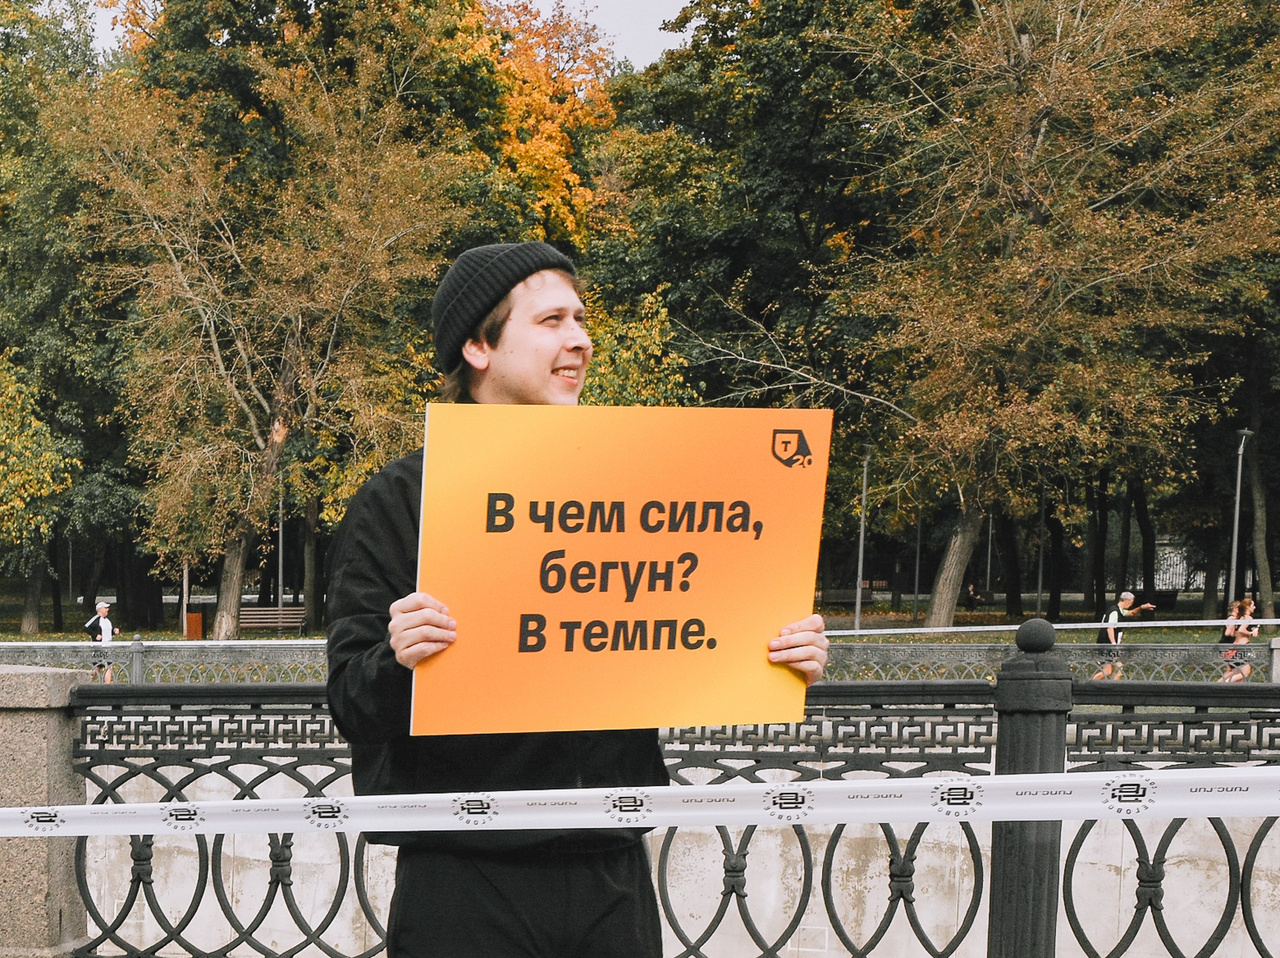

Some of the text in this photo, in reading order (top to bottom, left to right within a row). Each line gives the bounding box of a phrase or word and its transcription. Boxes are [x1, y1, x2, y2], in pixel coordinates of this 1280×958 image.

[485, 492, 764, 541] В чем сила,
[540, 549, 699, 603] бегун?
[518, 613, 717, 653] В темпе.
